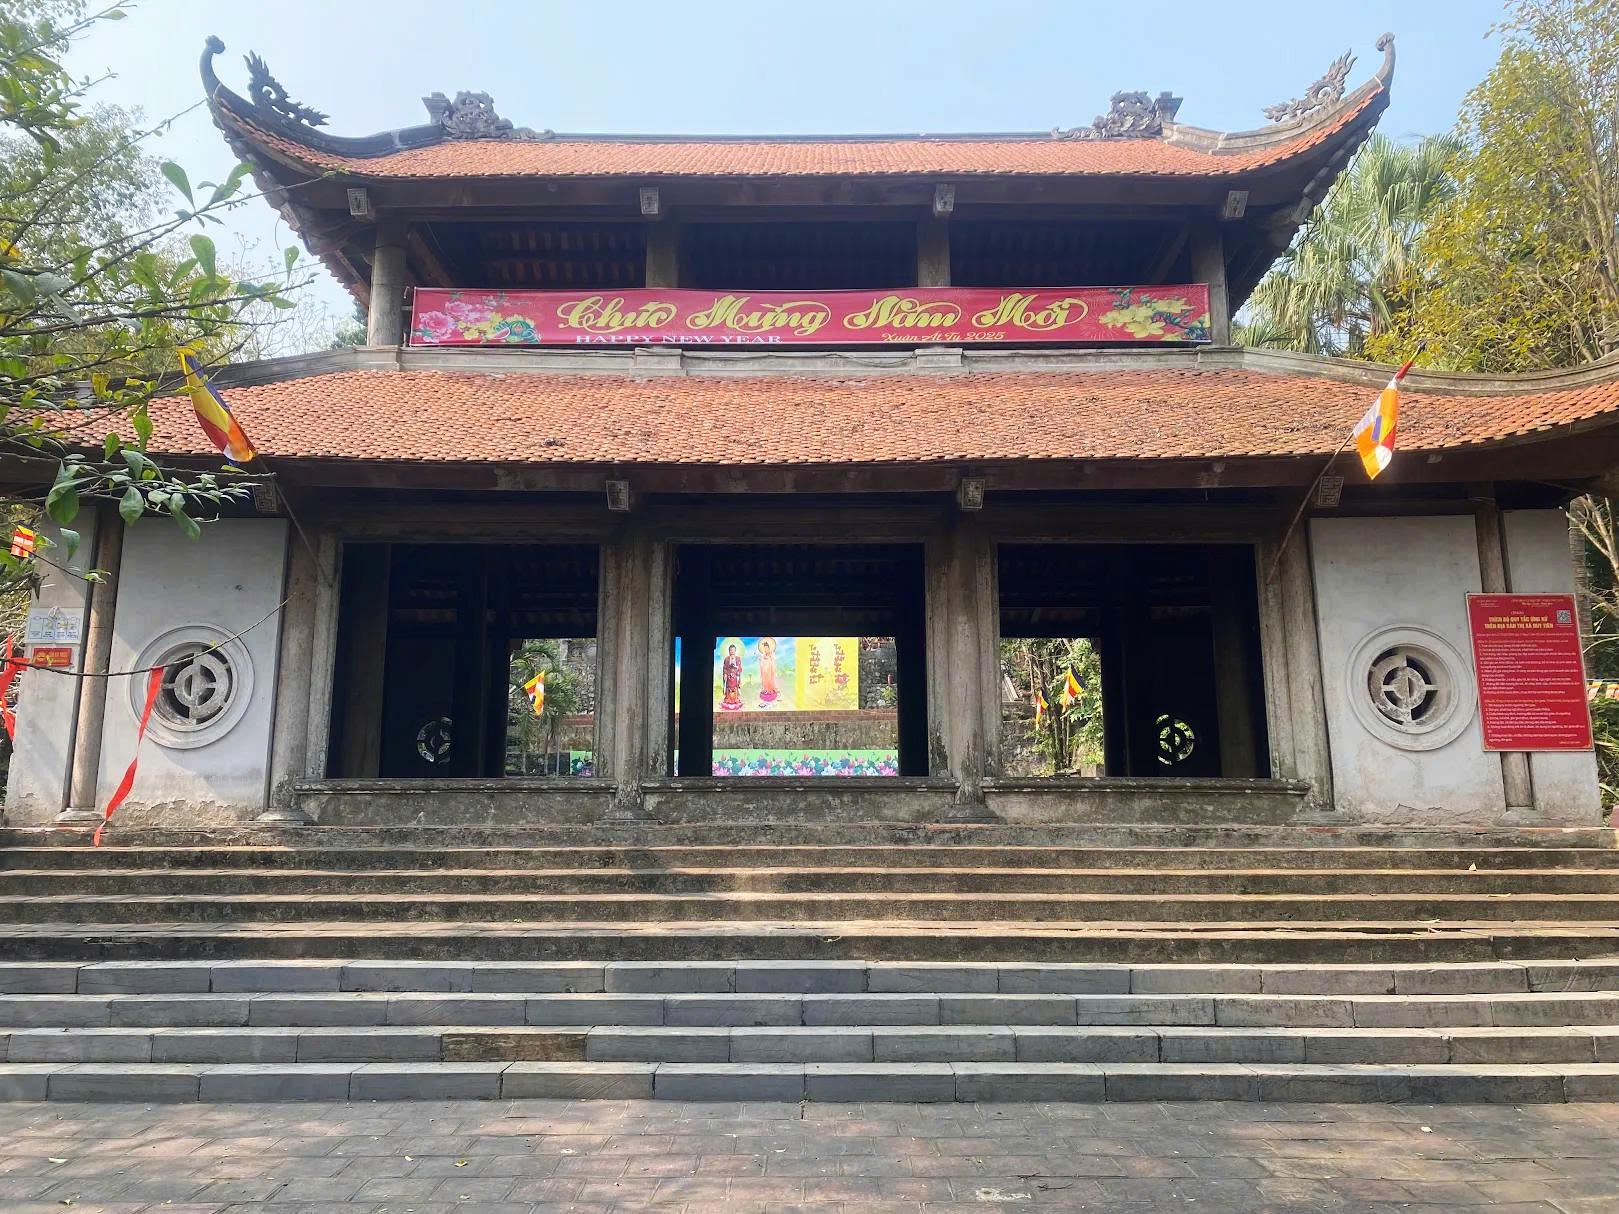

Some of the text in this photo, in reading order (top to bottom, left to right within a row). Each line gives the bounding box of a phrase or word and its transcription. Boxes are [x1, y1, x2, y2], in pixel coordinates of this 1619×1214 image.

[557, 293, 1089, 336] Chúc Mừng Năm Mới
[576, 335, 783, 343] HAPPY NEW YEAR
[965, 331, 1006, 340] 2025
